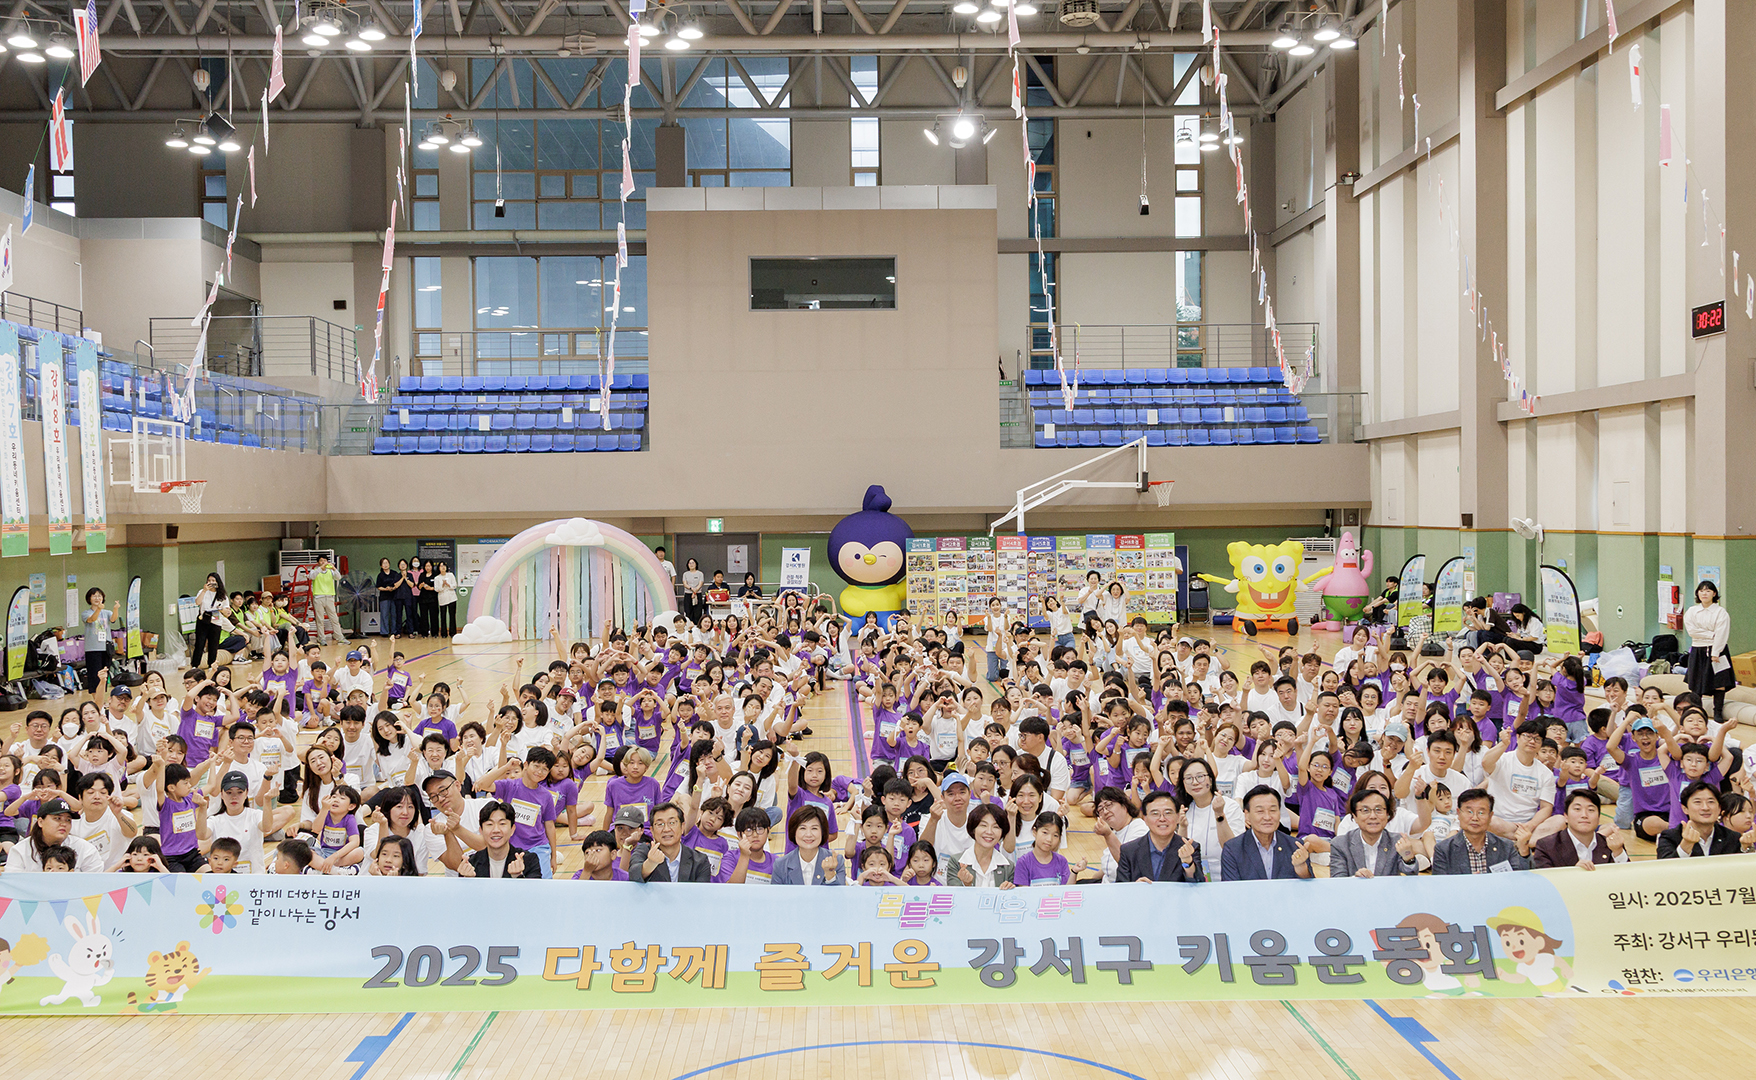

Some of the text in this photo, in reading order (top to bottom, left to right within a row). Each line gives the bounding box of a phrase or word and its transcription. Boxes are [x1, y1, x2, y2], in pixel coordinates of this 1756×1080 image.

[249, 888, 361, 906] 함께 더하는 미래
[1608, 886, 1756, 910] 일시: 2025년 7월
[248, 905, 361, 931] 같이 나누는 강서
[1613, 933, 1654, 951] 주최:
[1658, 931, 1711, 950] 강서구
[363, 944, 520, 990] 2025
[542, 940, 729, 993] 다함께
[754, 939, 940, 991] 즐거운
[967, 936, 1154, 988] 강서구
[1621, 968, 1664, 985] 협찬:
